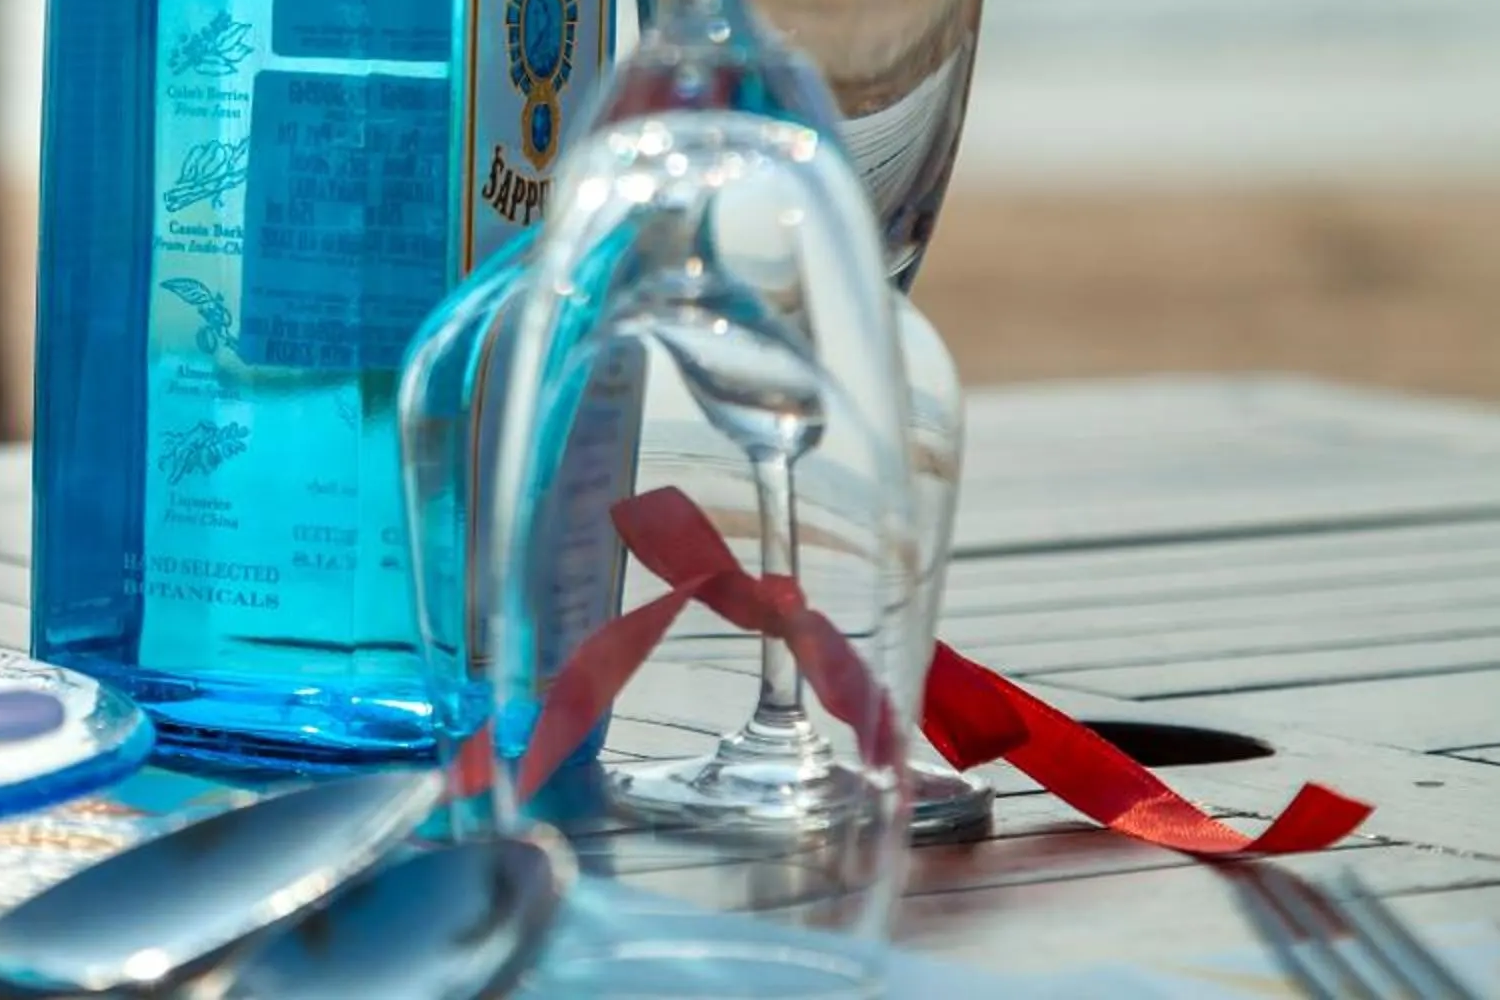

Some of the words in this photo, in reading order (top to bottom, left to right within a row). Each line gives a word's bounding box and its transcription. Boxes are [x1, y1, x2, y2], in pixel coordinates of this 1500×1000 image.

[482, 144, 553, 227] SAPP
[188, 239, 242, 255] Indo-Ch
[180, 558, 280, 585] SELECTED
[123, 578, 280, 611] BOTANICALS
